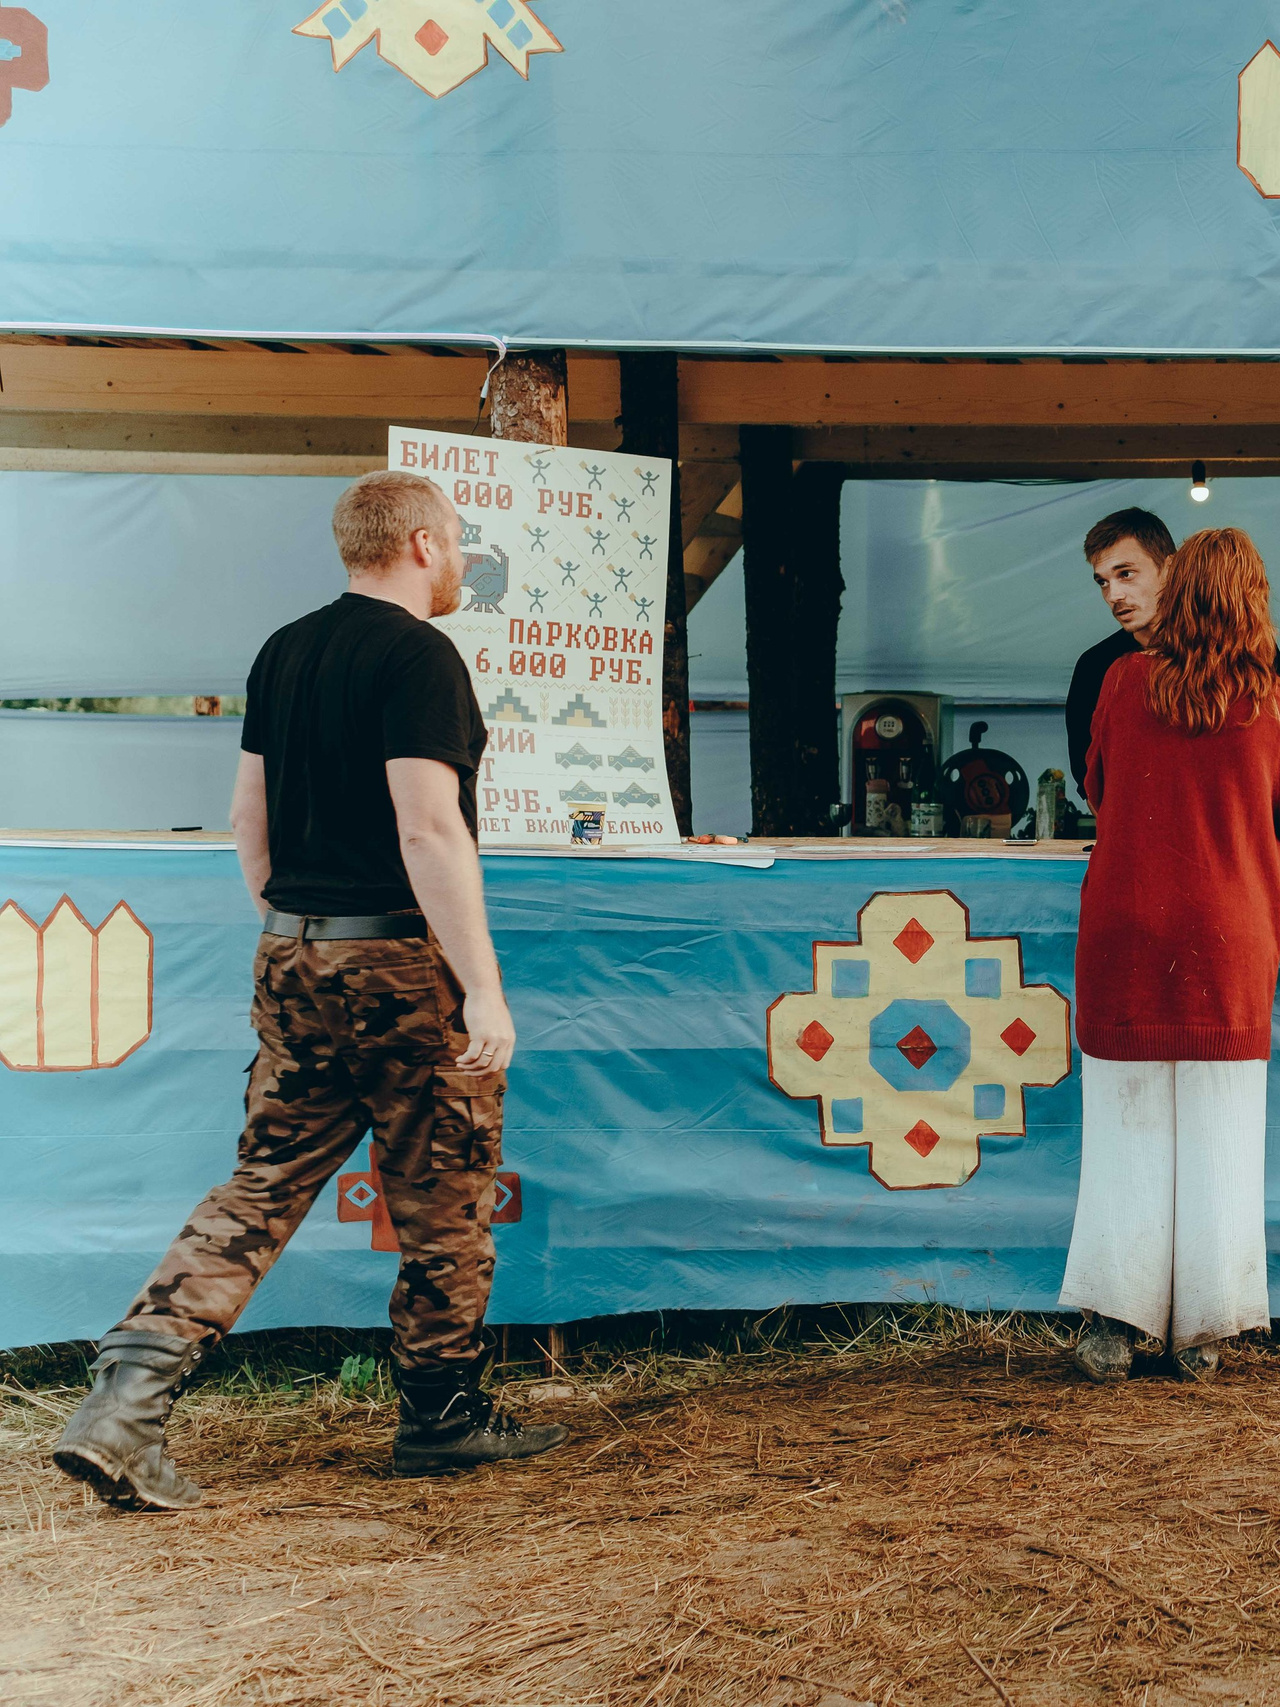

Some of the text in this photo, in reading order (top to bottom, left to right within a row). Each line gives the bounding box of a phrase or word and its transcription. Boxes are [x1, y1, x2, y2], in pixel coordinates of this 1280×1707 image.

[400, 440, 499, 477] БИЛЕТ
[425, 476, 603, 520] 000 РУБ.
[508, 618, 653, 655] ПАРКОВКА
[475, 647, 652, 686] 6.000 РУБ.
[482, 787, 552, 814] РУБ.
[525, 818, 663, 834] ВКЛЮЕЛЬНО
